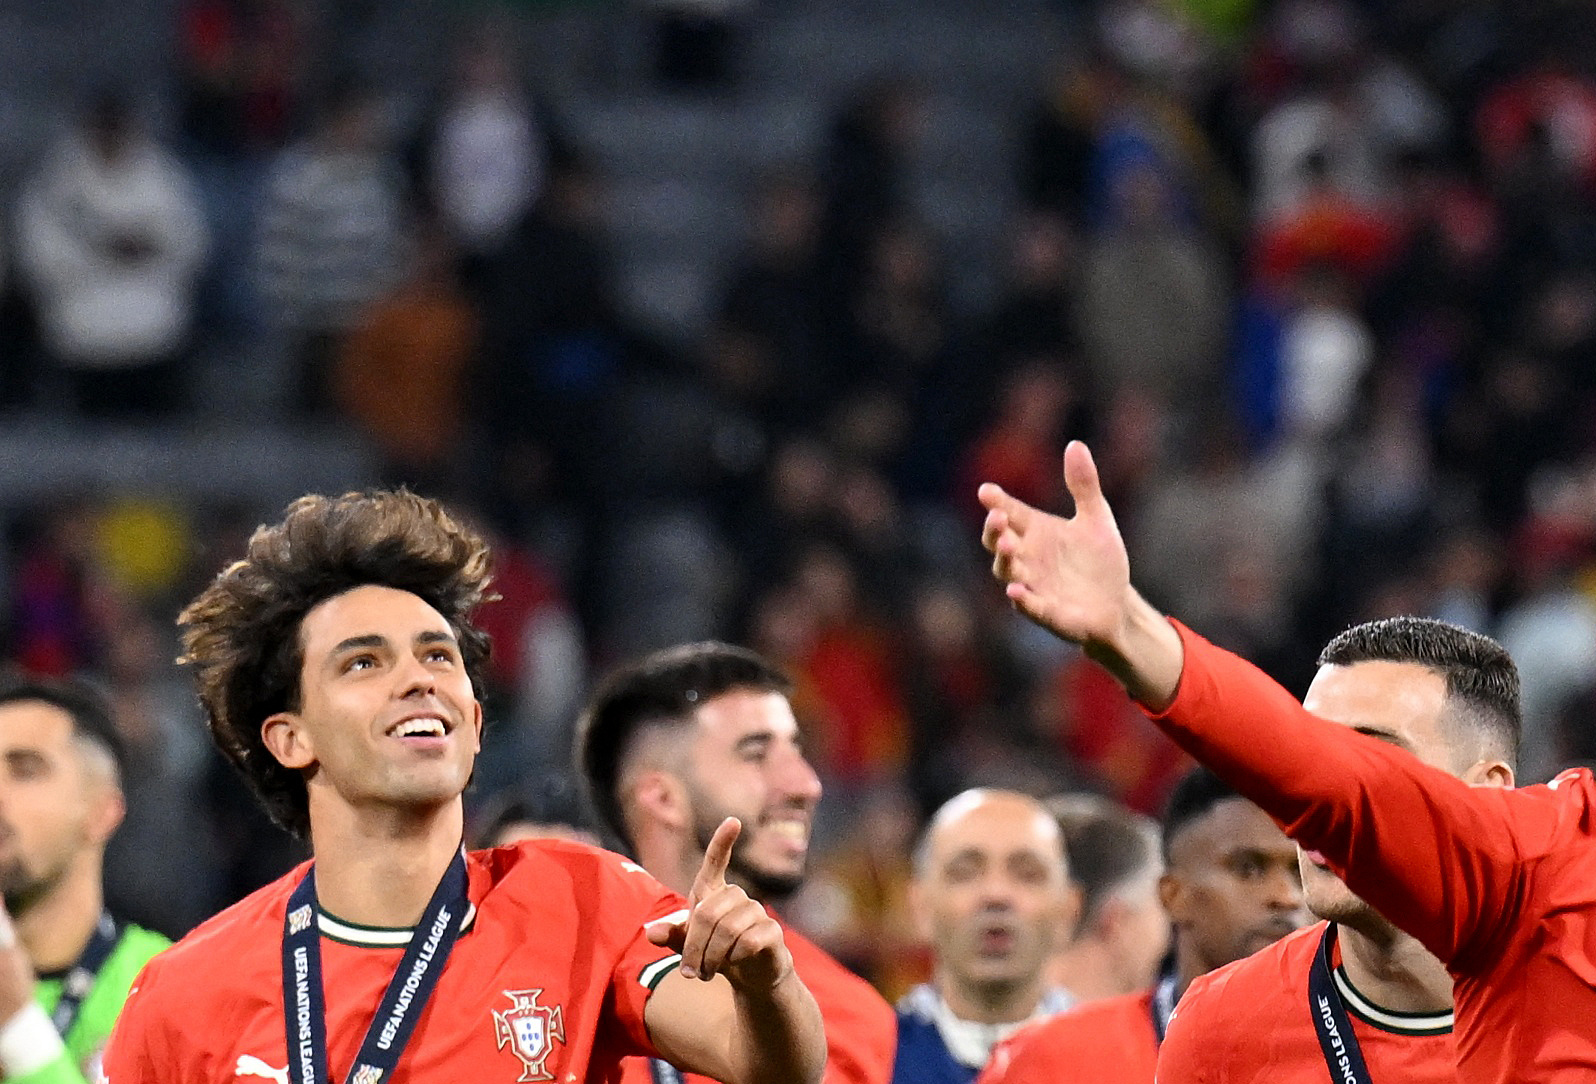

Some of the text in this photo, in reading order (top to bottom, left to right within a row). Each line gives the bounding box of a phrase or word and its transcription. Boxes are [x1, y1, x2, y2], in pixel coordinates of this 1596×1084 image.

[293, 945, 310, 983] UEFA
[376, 904, 452, 1050] UEFA NATIONS LEAGUE
[295, 980, 313, 1041] NATIONS
[1317, 994, 1347, 1057] LEAGUE
